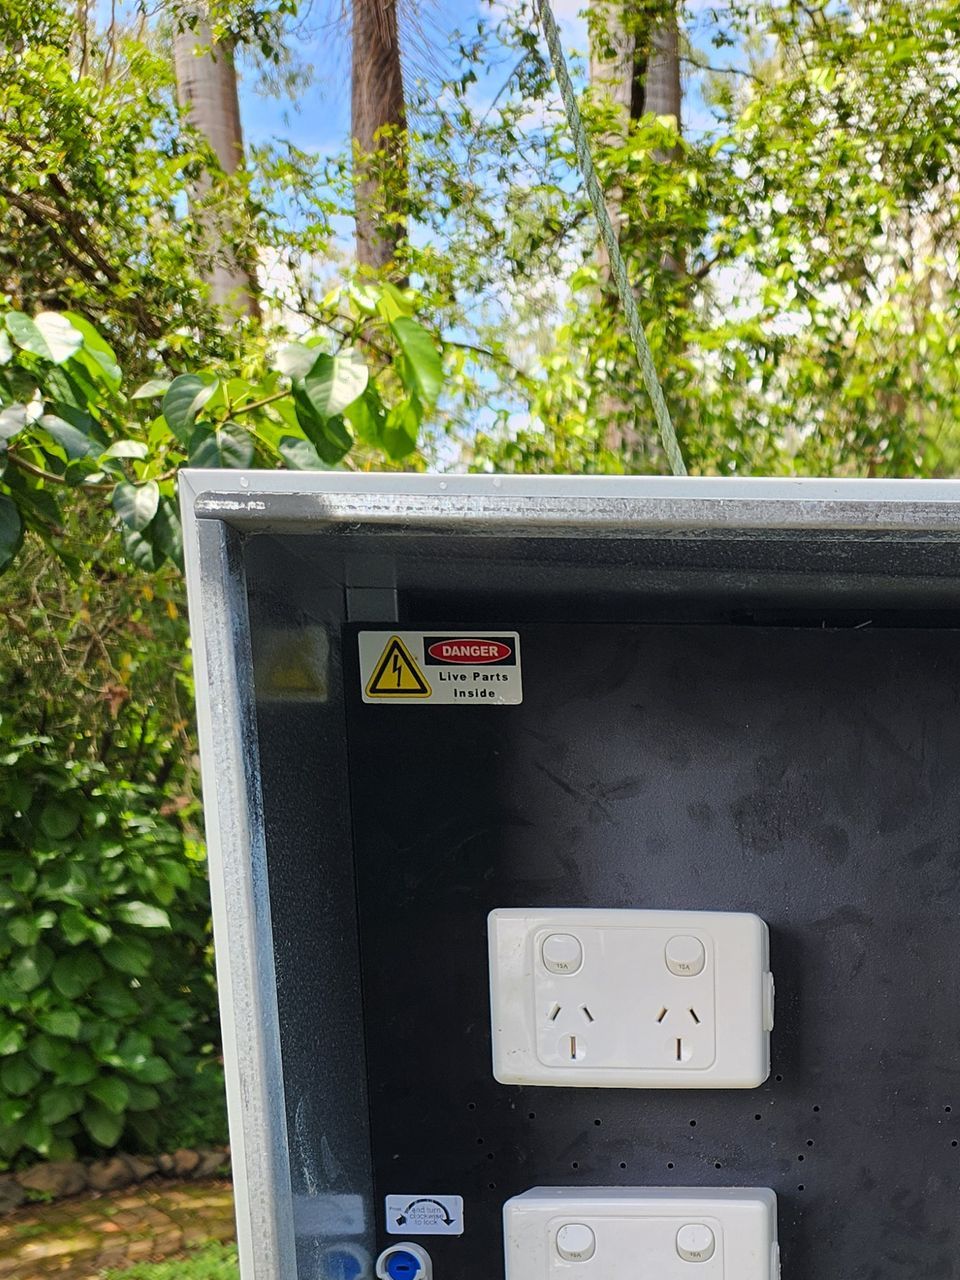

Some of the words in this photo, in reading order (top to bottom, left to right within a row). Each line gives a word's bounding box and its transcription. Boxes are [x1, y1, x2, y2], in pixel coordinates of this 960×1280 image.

[442, 645, 498, 657] DANGER
[439, 672, 467, 681] Live
[473, 672, 508, 681] Parts
[454, 688, 496, 698] Inside
